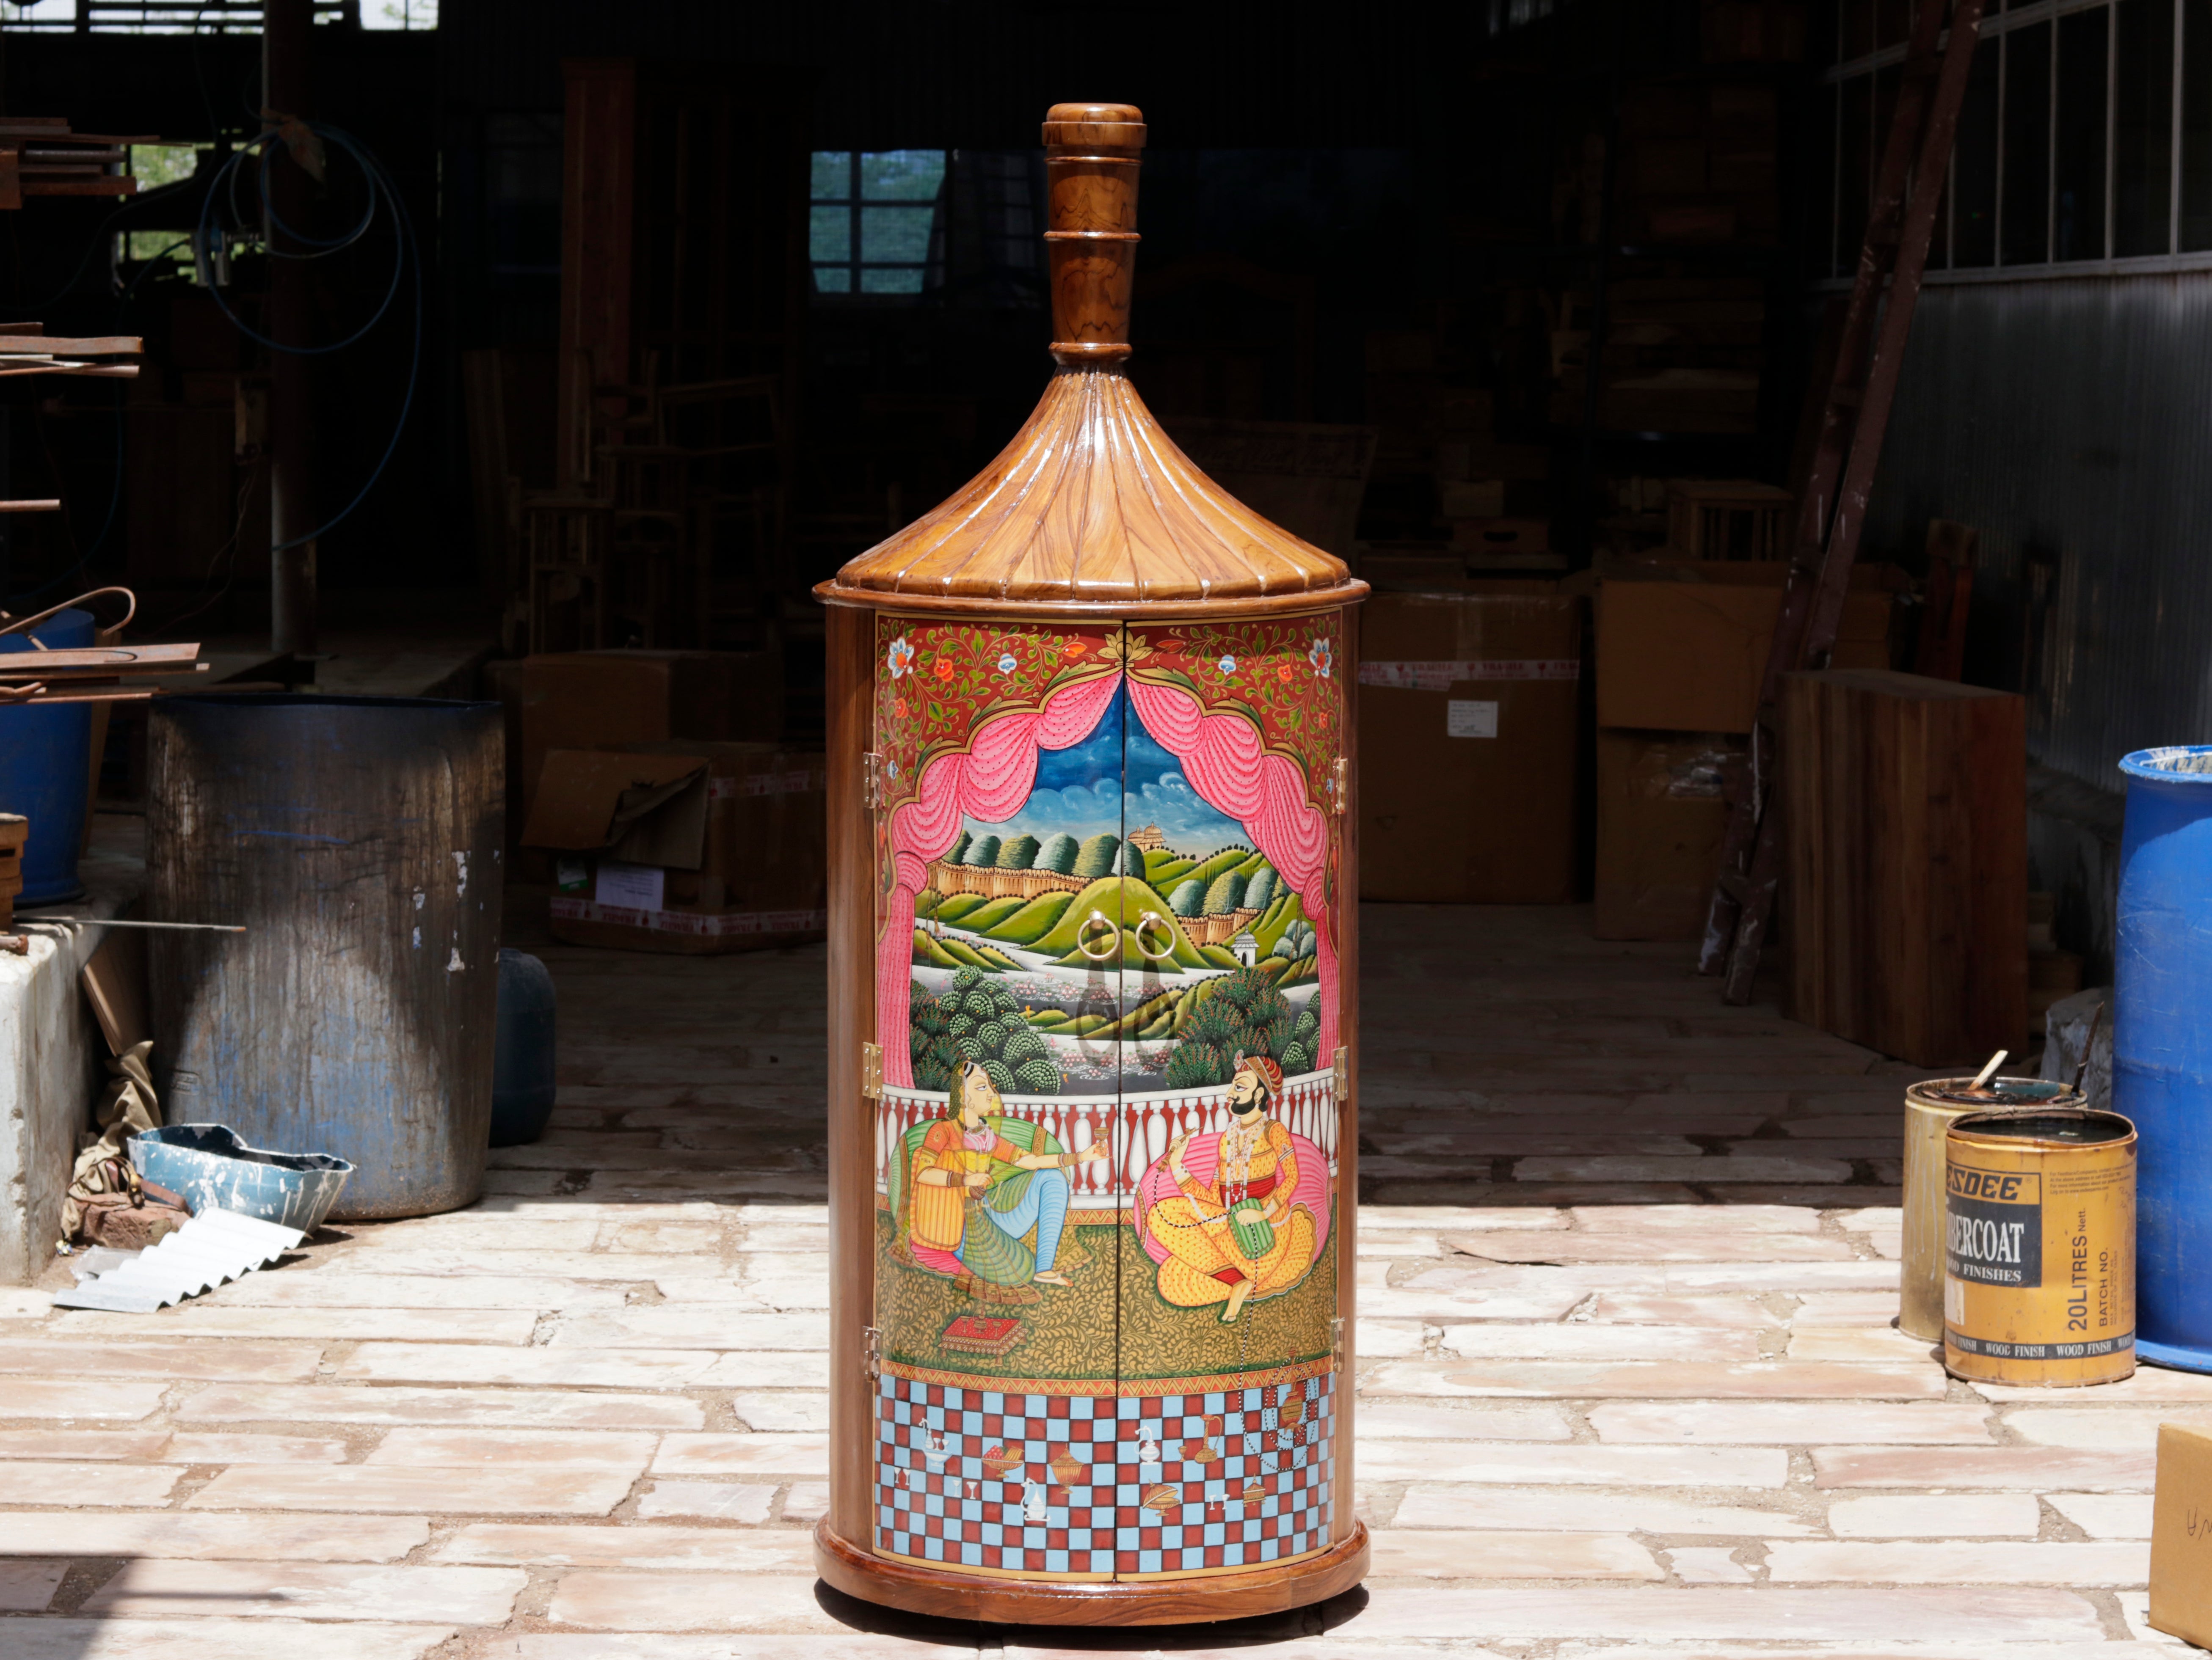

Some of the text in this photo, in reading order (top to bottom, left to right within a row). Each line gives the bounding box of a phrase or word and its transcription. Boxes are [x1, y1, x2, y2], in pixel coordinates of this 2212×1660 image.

[2078, 1208, 2086, 1232] Nett.
[1963, 1263, 2022, 1282] FINISHES
[2099, 1247, 2108, 1327] BATCH NO.
[1957, 1336, 1977, 1352] FINISH
[1986, 1342, 2011, 1356] WOOD
[2014, 1345, 2045, 1357] FINISH
[2056, 1343, 2084, 1357] WOOD
[2087, 1340, 2112, 1354] FINISH
